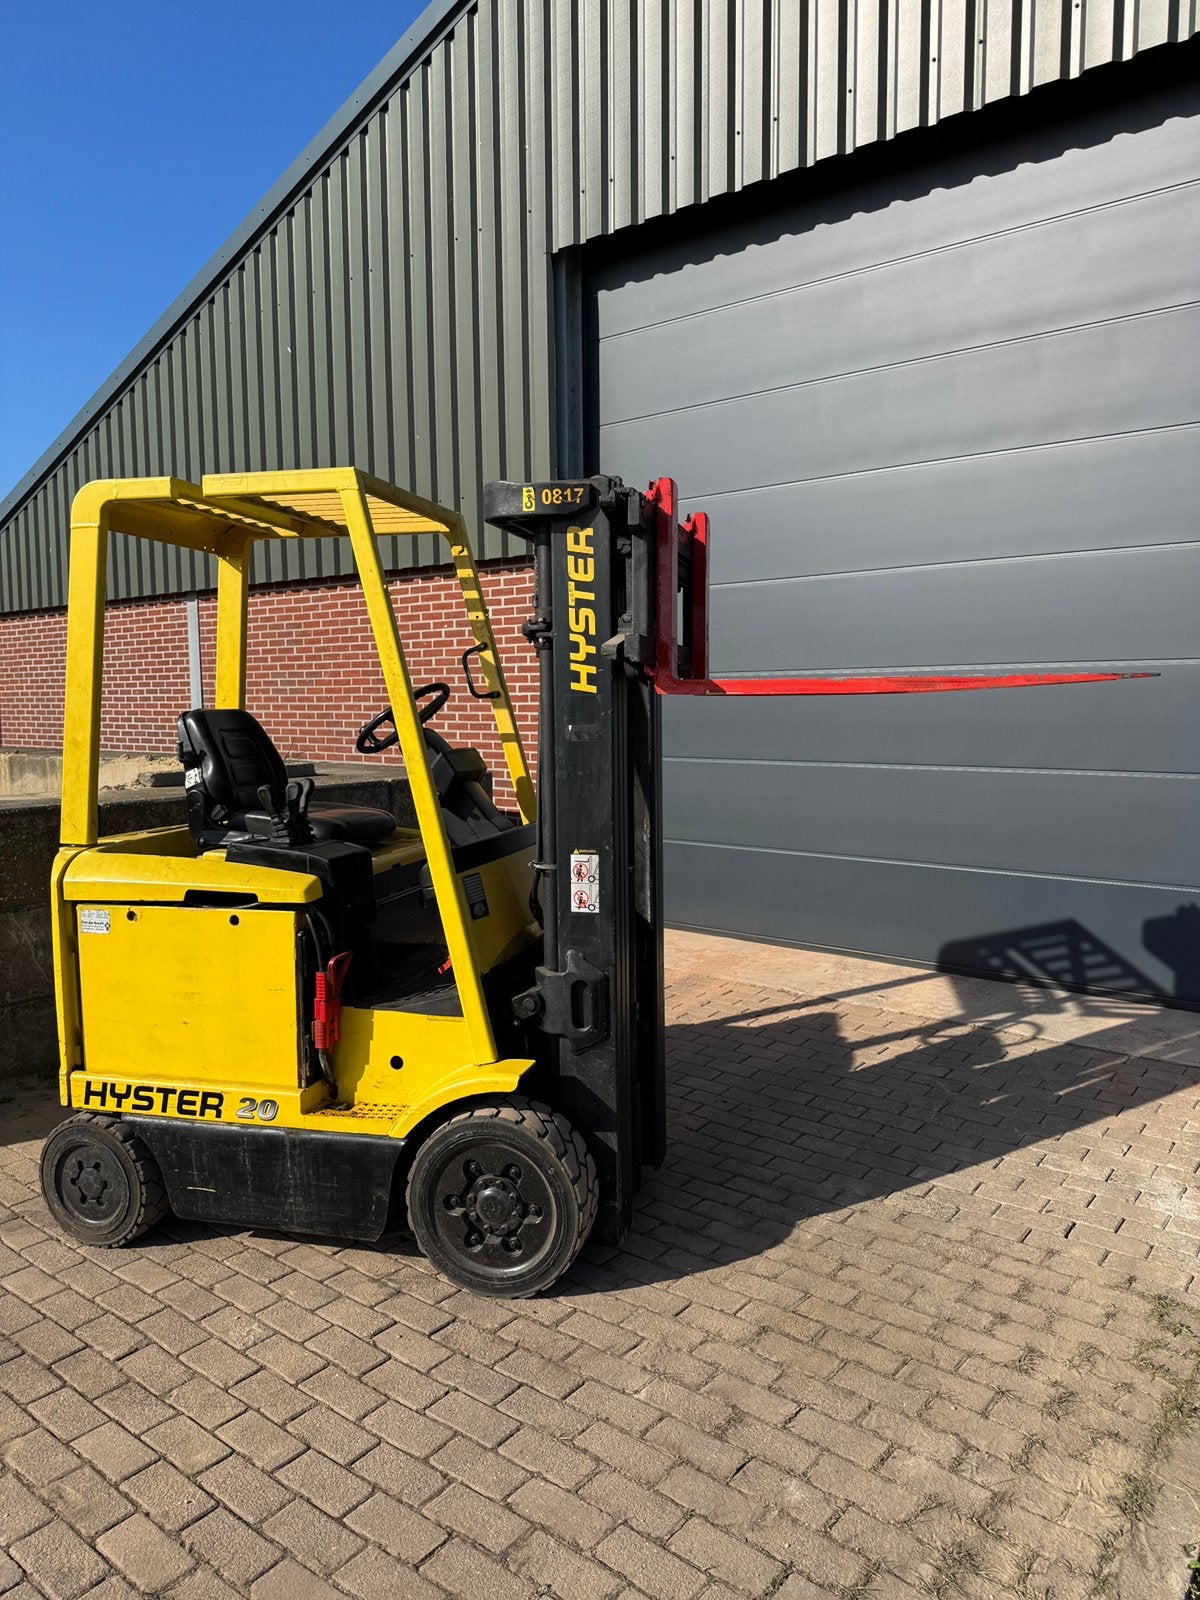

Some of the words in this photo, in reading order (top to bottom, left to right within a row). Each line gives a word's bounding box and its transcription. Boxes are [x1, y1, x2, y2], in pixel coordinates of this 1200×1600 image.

[541, 487, 584, 505] 0817
[566, 525, 597, 694] HYSTER
[84, 1080, 225, 1119] HYSTER
[236, 1097, 280, 1121] 20
